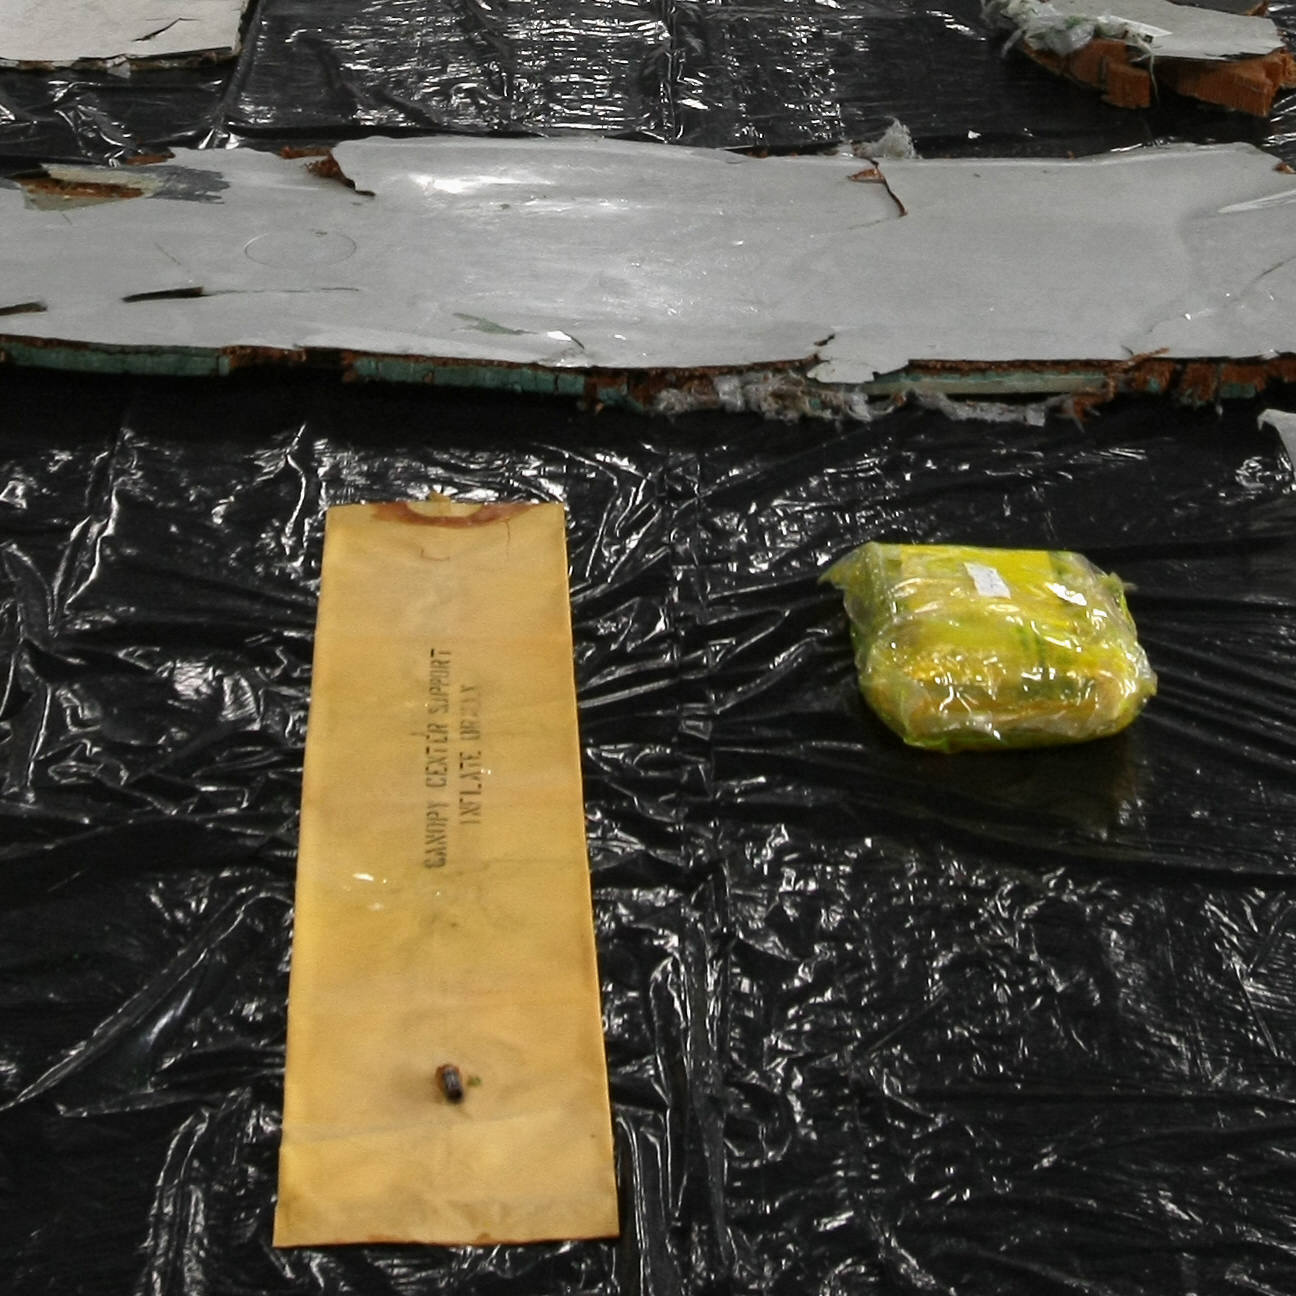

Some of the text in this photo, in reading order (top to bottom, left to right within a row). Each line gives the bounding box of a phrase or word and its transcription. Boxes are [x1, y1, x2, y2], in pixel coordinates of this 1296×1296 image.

[423, 647, 452, 869] CANOPY CENTER SUPPORT
[458, 751, 483, 825] INFLATE
